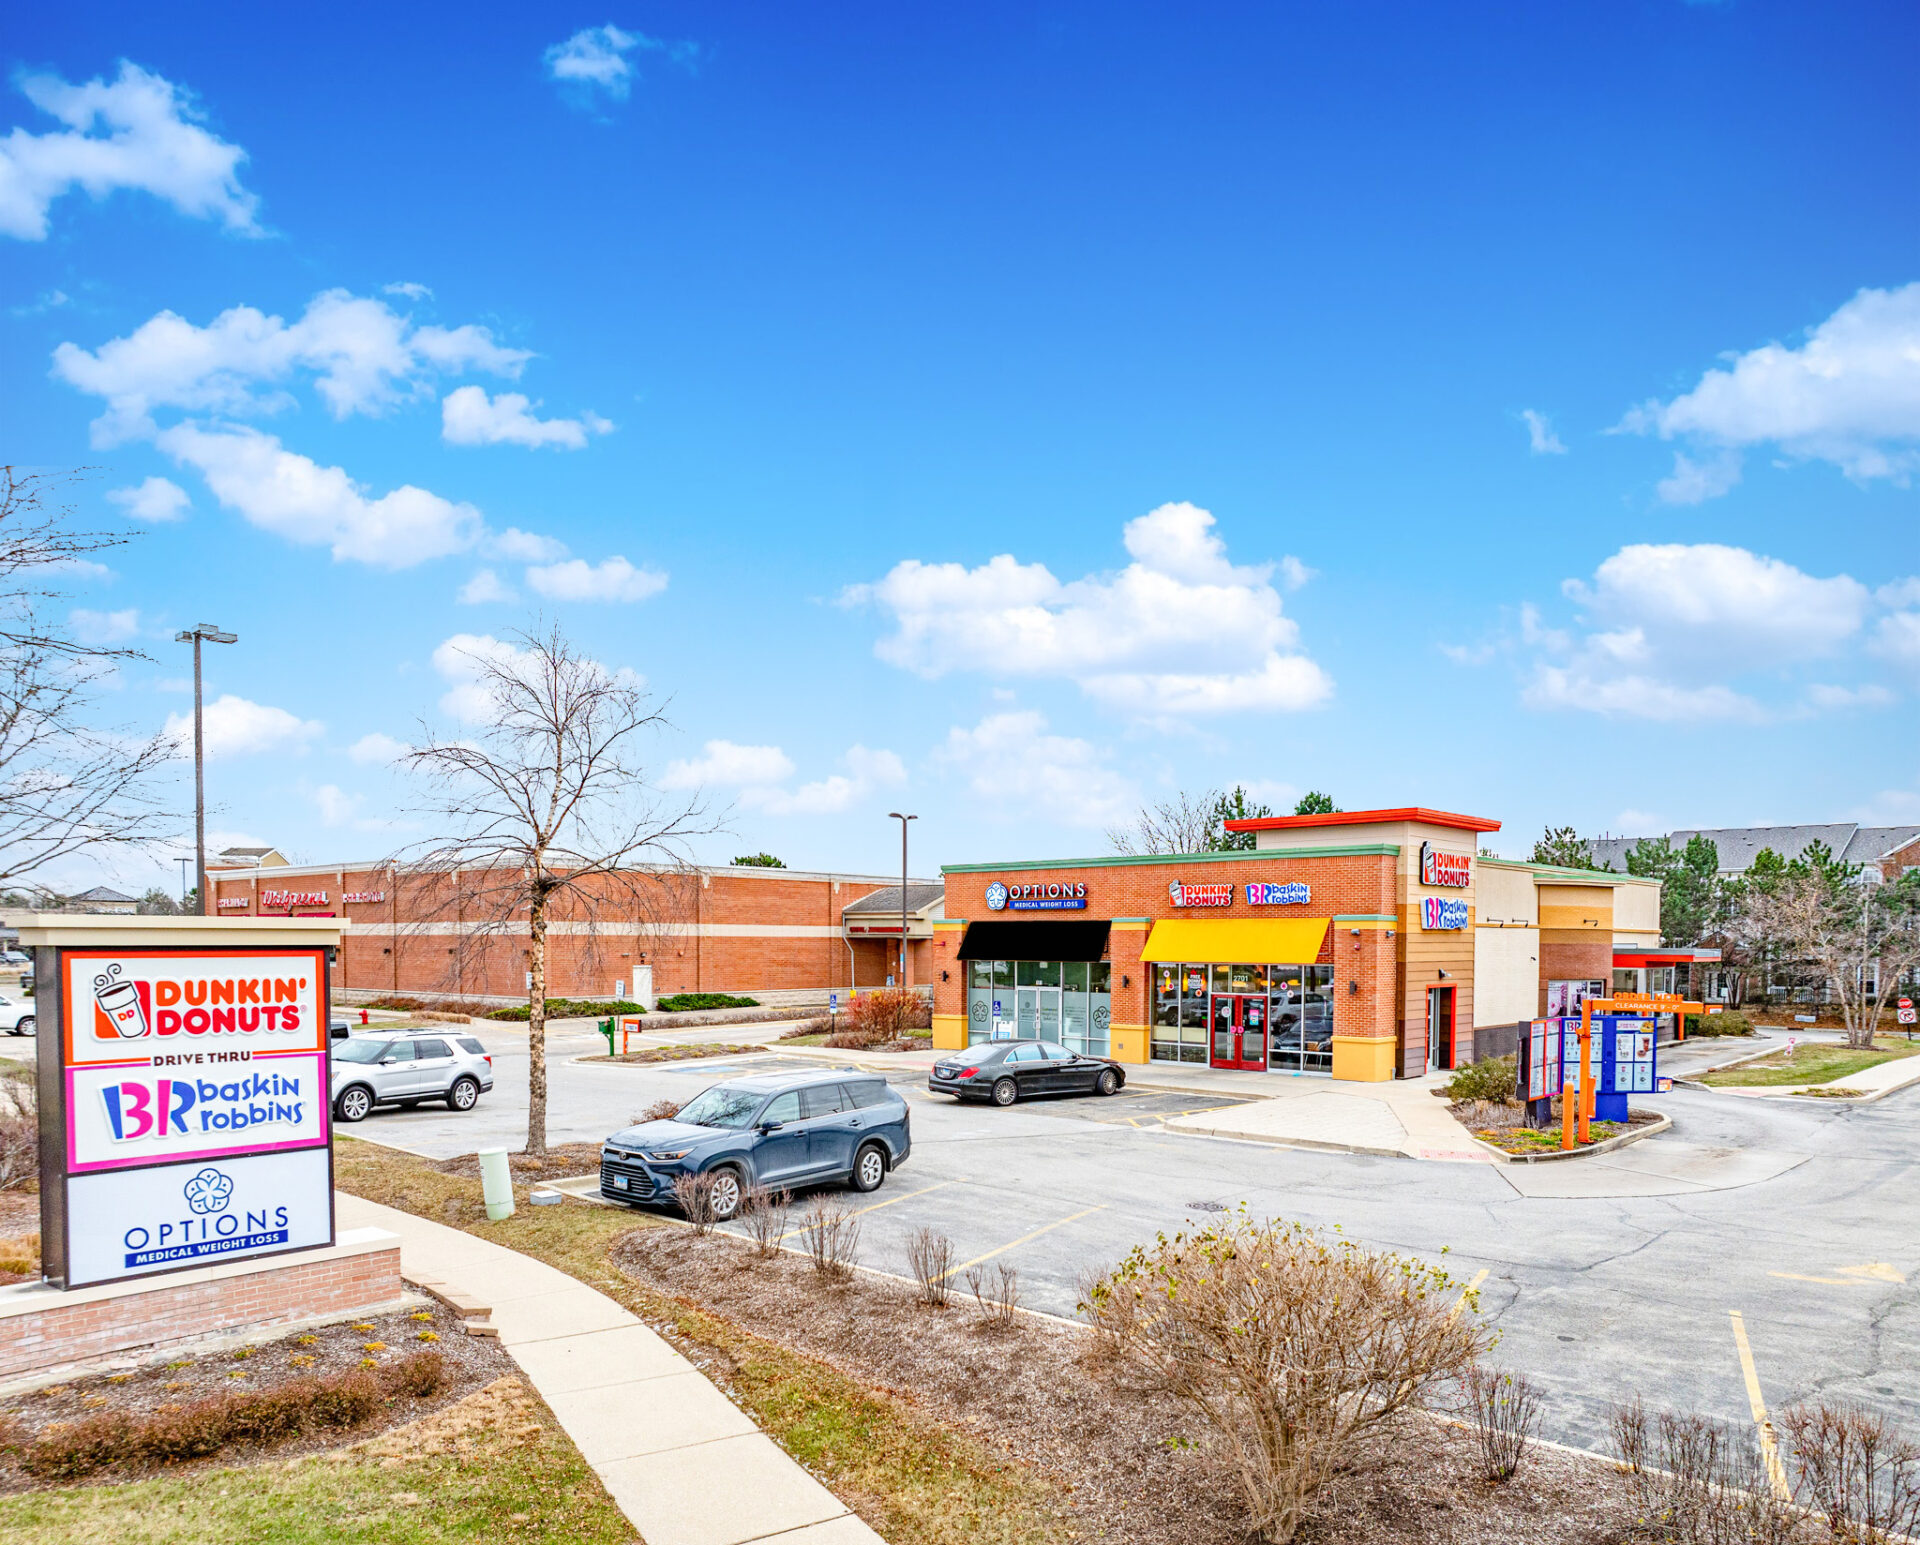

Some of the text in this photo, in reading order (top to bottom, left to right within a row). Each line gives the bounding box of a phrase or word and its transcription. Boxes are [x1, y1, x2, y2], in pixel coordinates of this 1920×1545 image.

[1437, 852, 1471, 870] DUNKIN'
[1437, 870, 1469, 886] DONUTS
[1009, 883, 1085, 899] OPTIONS
[1186, 885, 1232, 895] DUNKIN'
[1246, 884, 1272, 904] BR
[261, 890, 329, 912] Walgreens
[1186, 896, 1230, 906] DONUTS
[1425, 897, 1443, 928] BR
[156, 978, 307, 1007] DUNKIN'
[1613, 992, 1651, 1001] ORDER
[117, 1009, 135, 1022] DD
[1615, 1002, 1657, 1010] CLEARANCE
[157, 1005, 300, 1036] DONUTS
[154, 1051, 250, 1067] DRIVE THRU
[196, 1073, 299, 1103] baskin
[102, 1079, 196, 1139] BR
[200, 1101, 303, 1131] robbins
[124, 1206, 289, 1250] OPTIONS
[135, 1233, 279, 1264] MEDICAL WEIGHT LOSS
